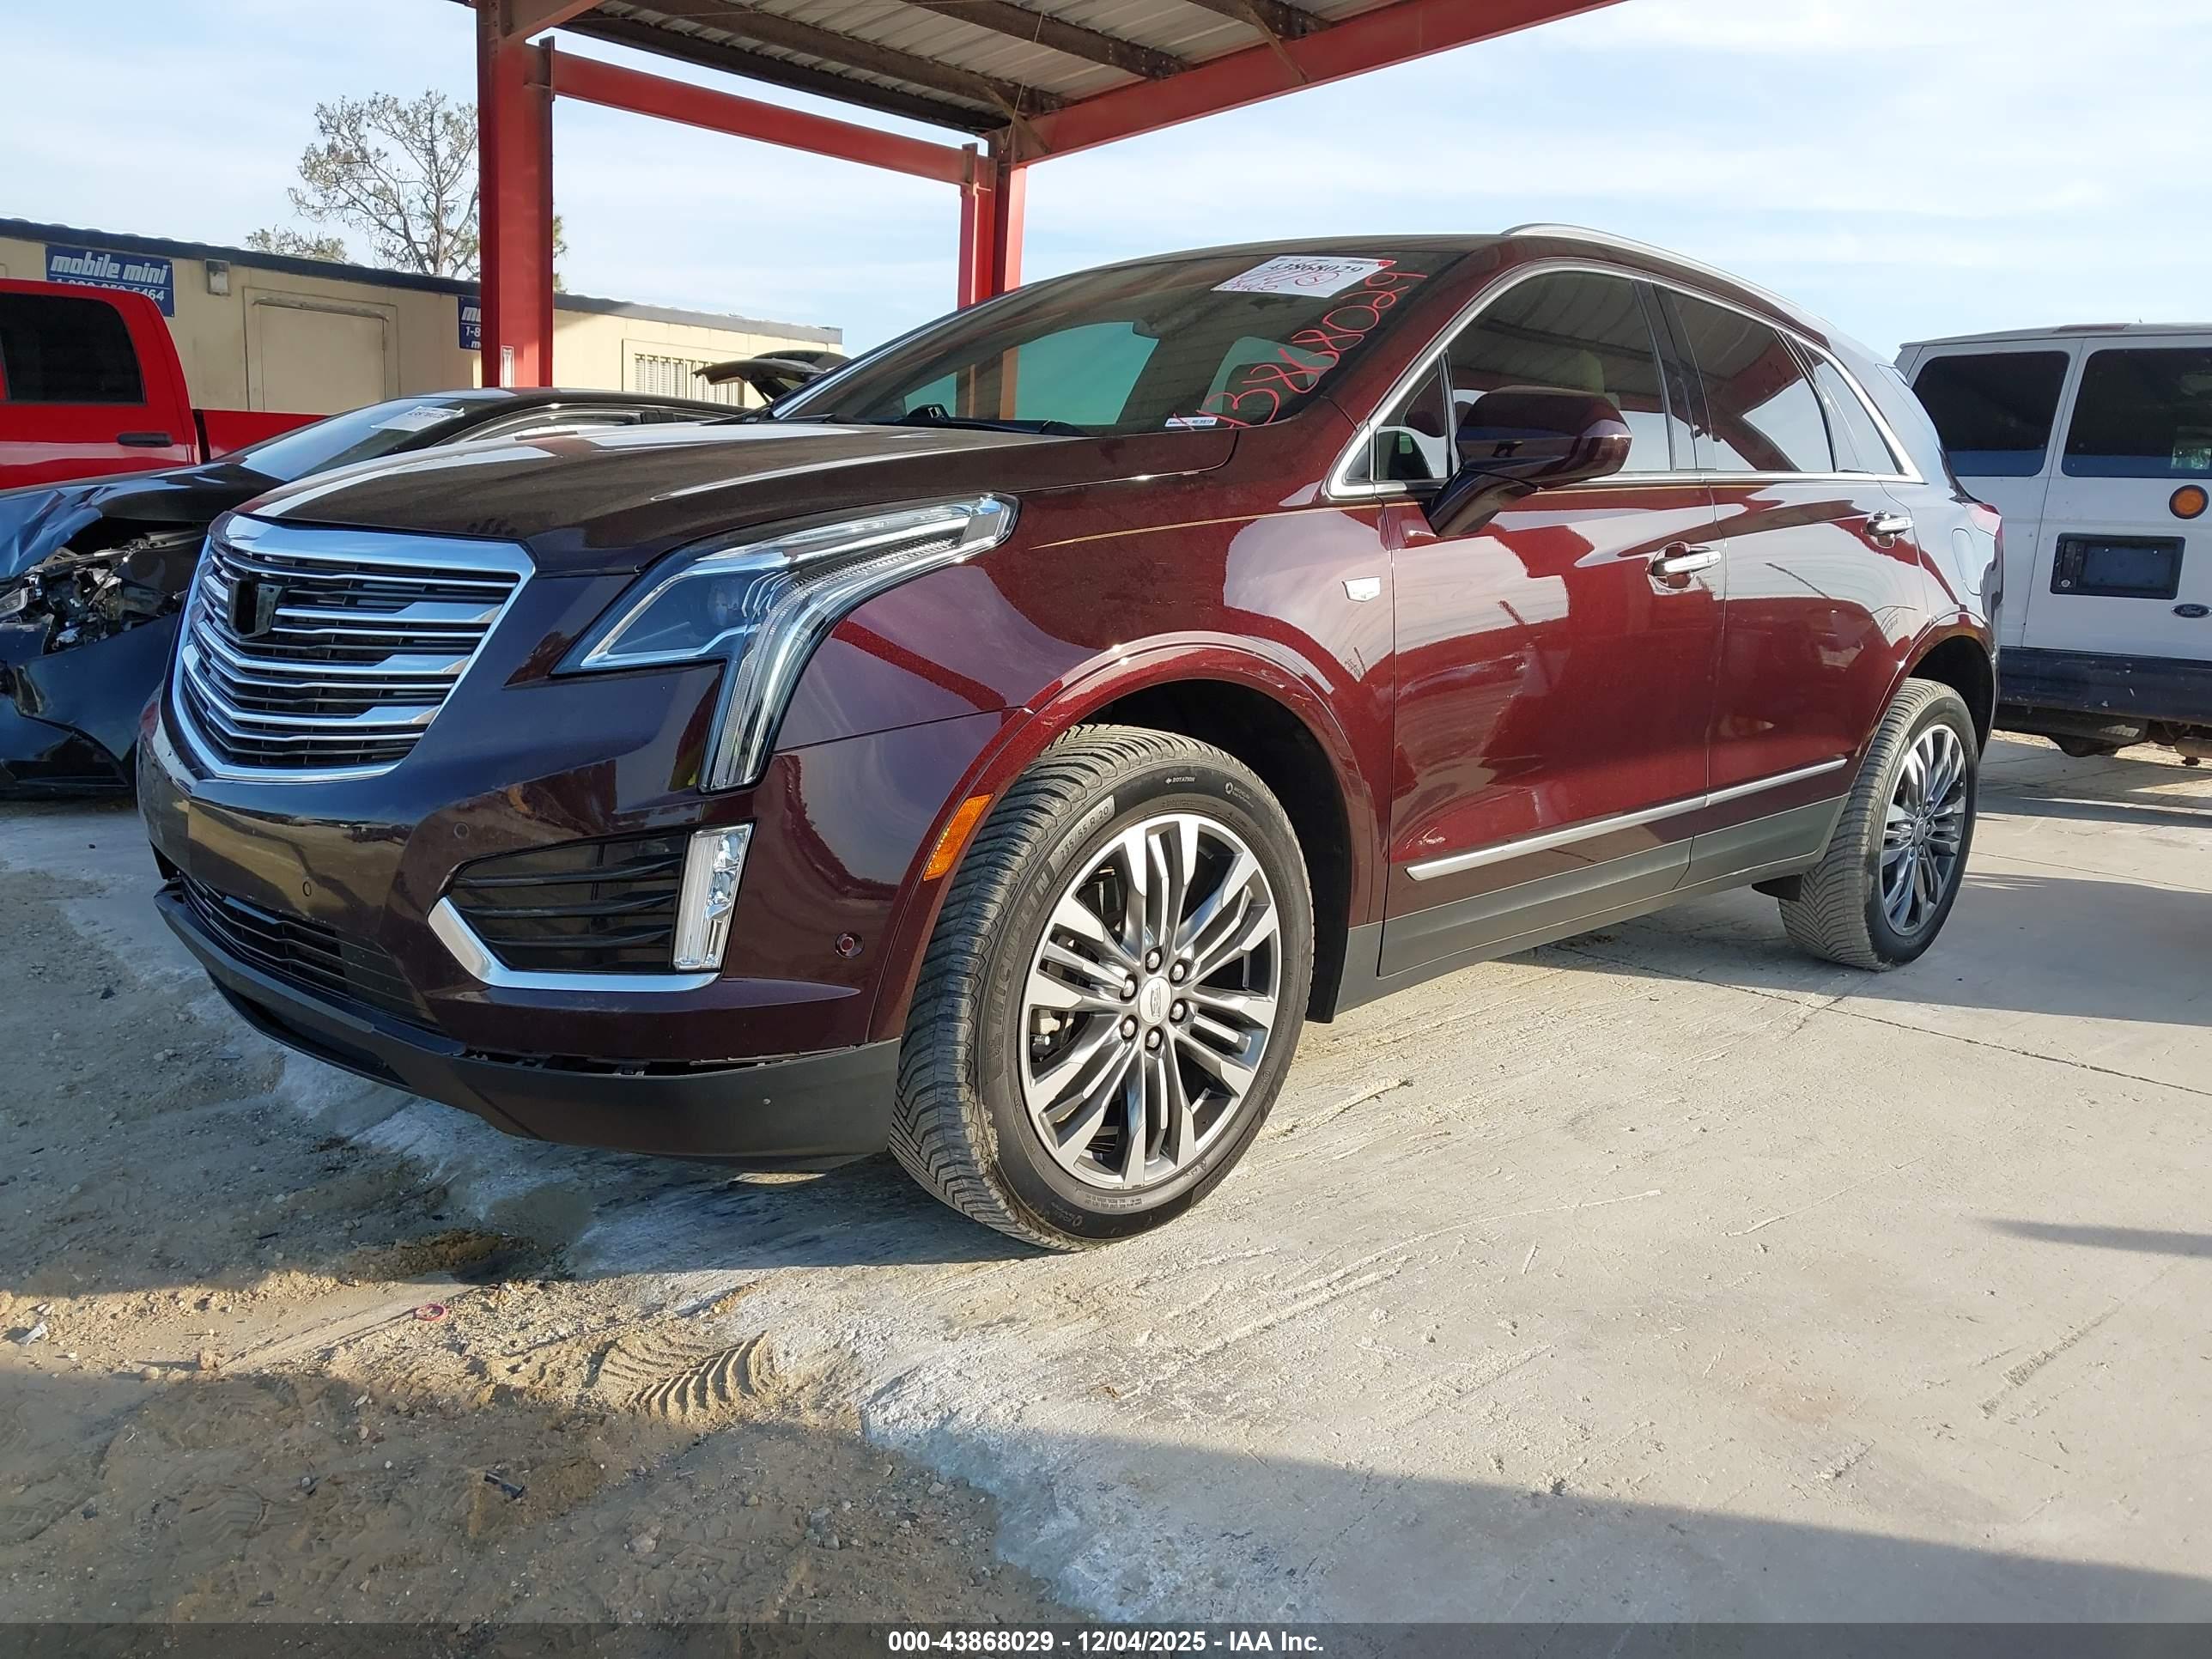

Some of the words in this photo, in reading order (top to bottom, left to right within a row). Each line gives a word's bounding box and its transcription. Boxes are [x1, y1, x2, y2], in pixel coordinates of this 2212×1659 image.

[50, 251, 120, 279] mobile
[122, 262, 168, 284] mini
[1060, 824, 1088, 860] 235/55
[1090, 817, 1096, 827] R
[1099, 805, 1109, 819] 20
